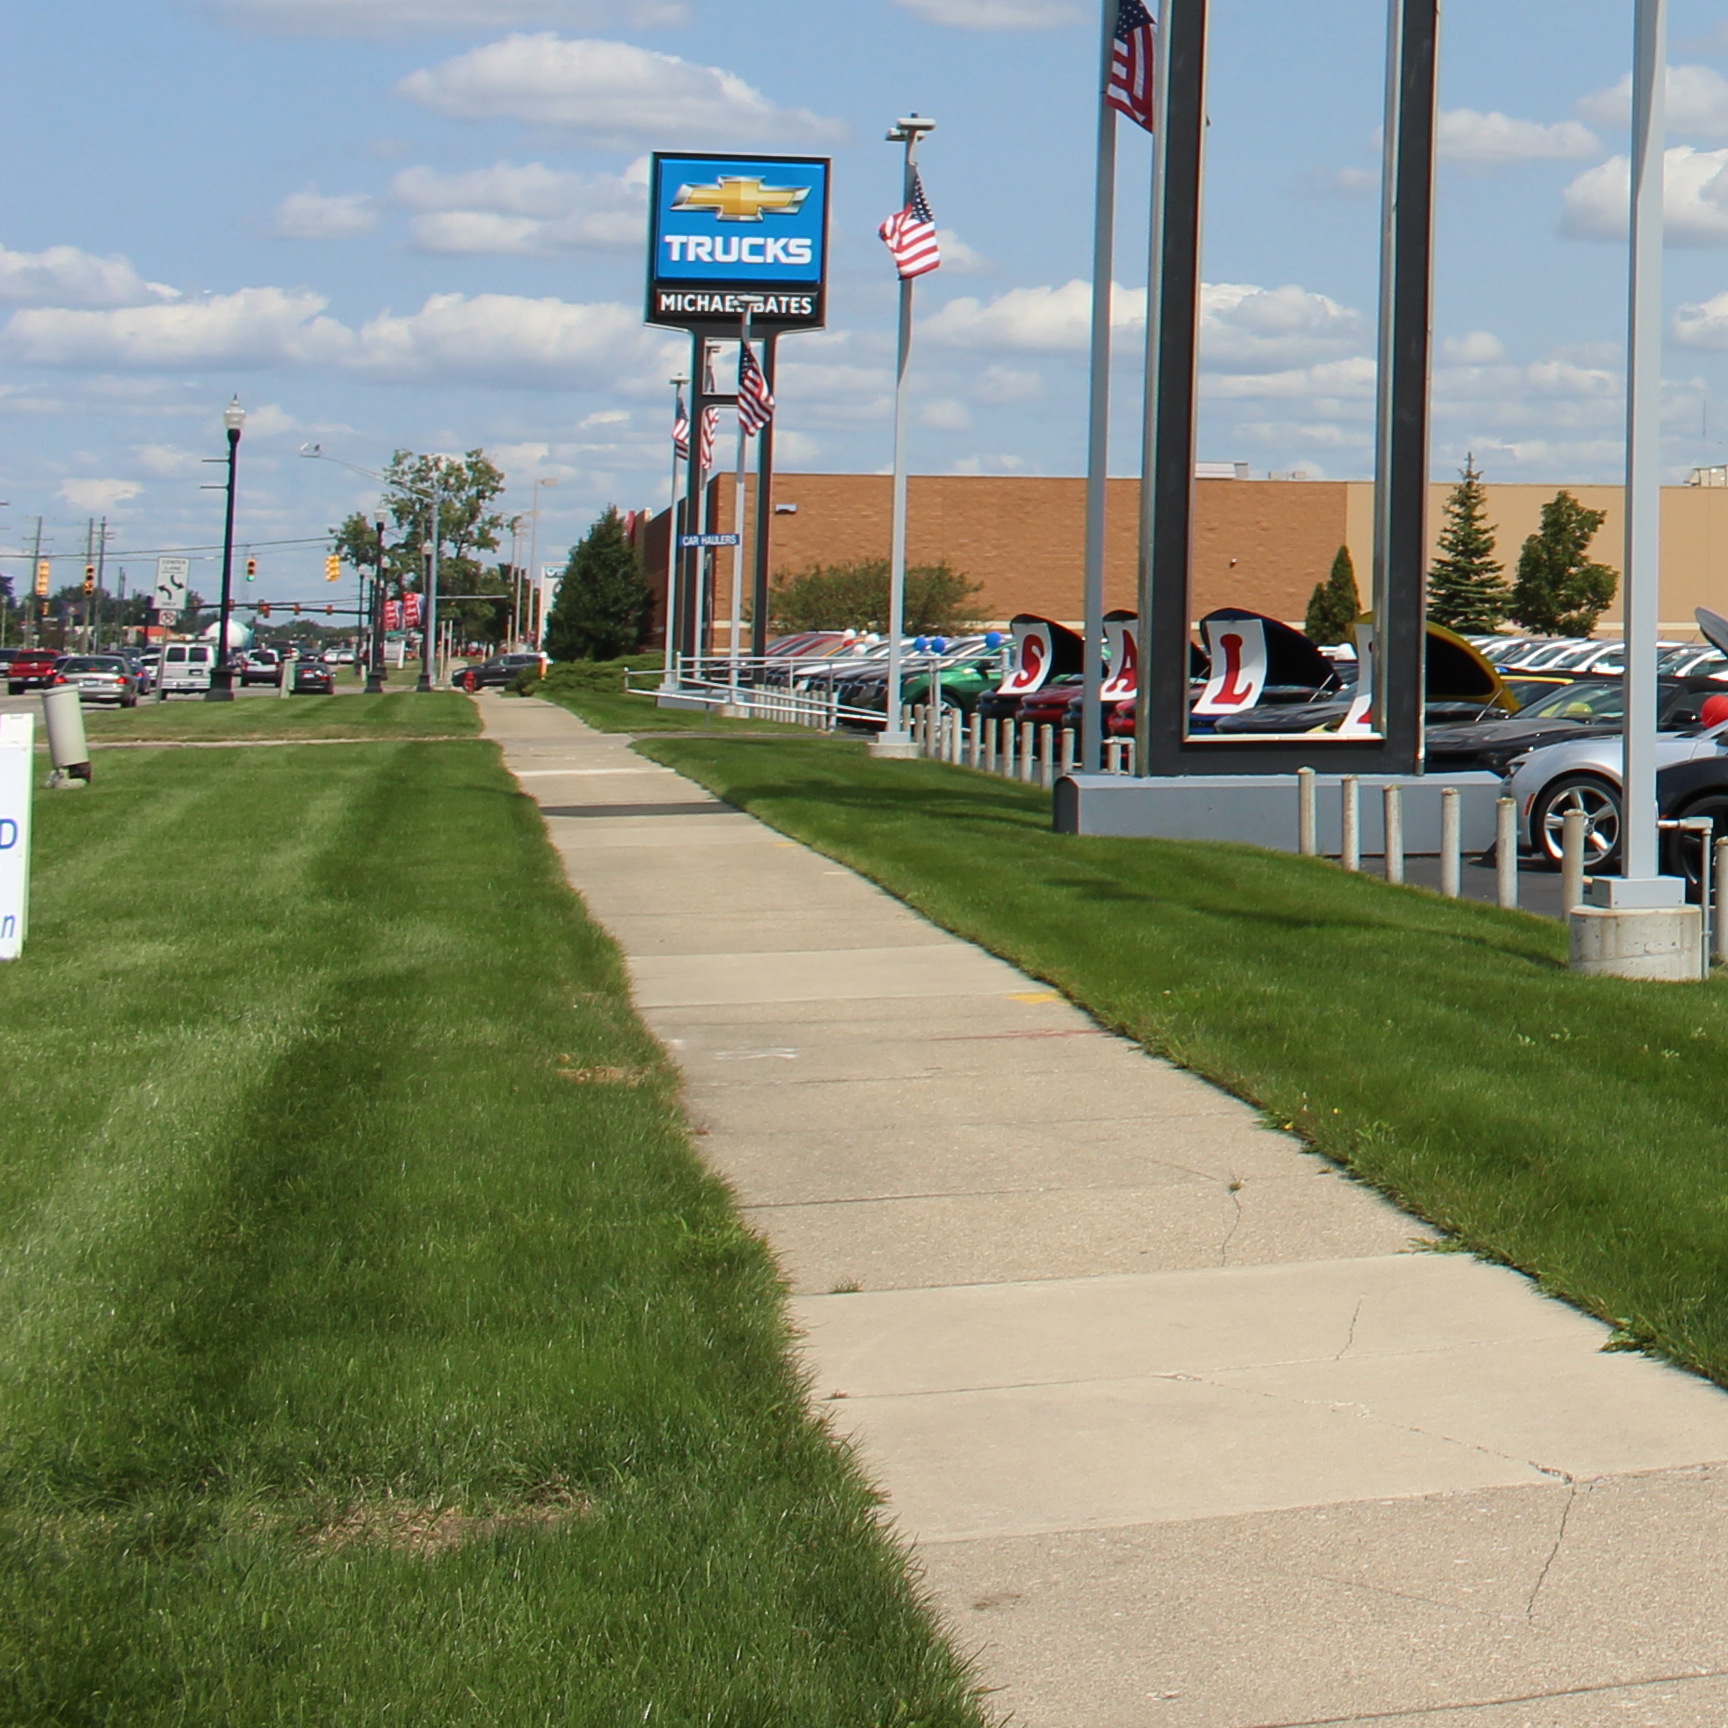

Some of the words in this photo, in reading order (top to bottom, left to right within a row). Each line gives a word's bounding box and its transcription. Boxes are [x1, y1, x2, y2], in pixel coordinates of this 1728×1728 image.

[664, 235, 812, 265] TRUCKS
[682, 535, 699, 546] CAR
[701, 534, 737, 544] HAULERS
